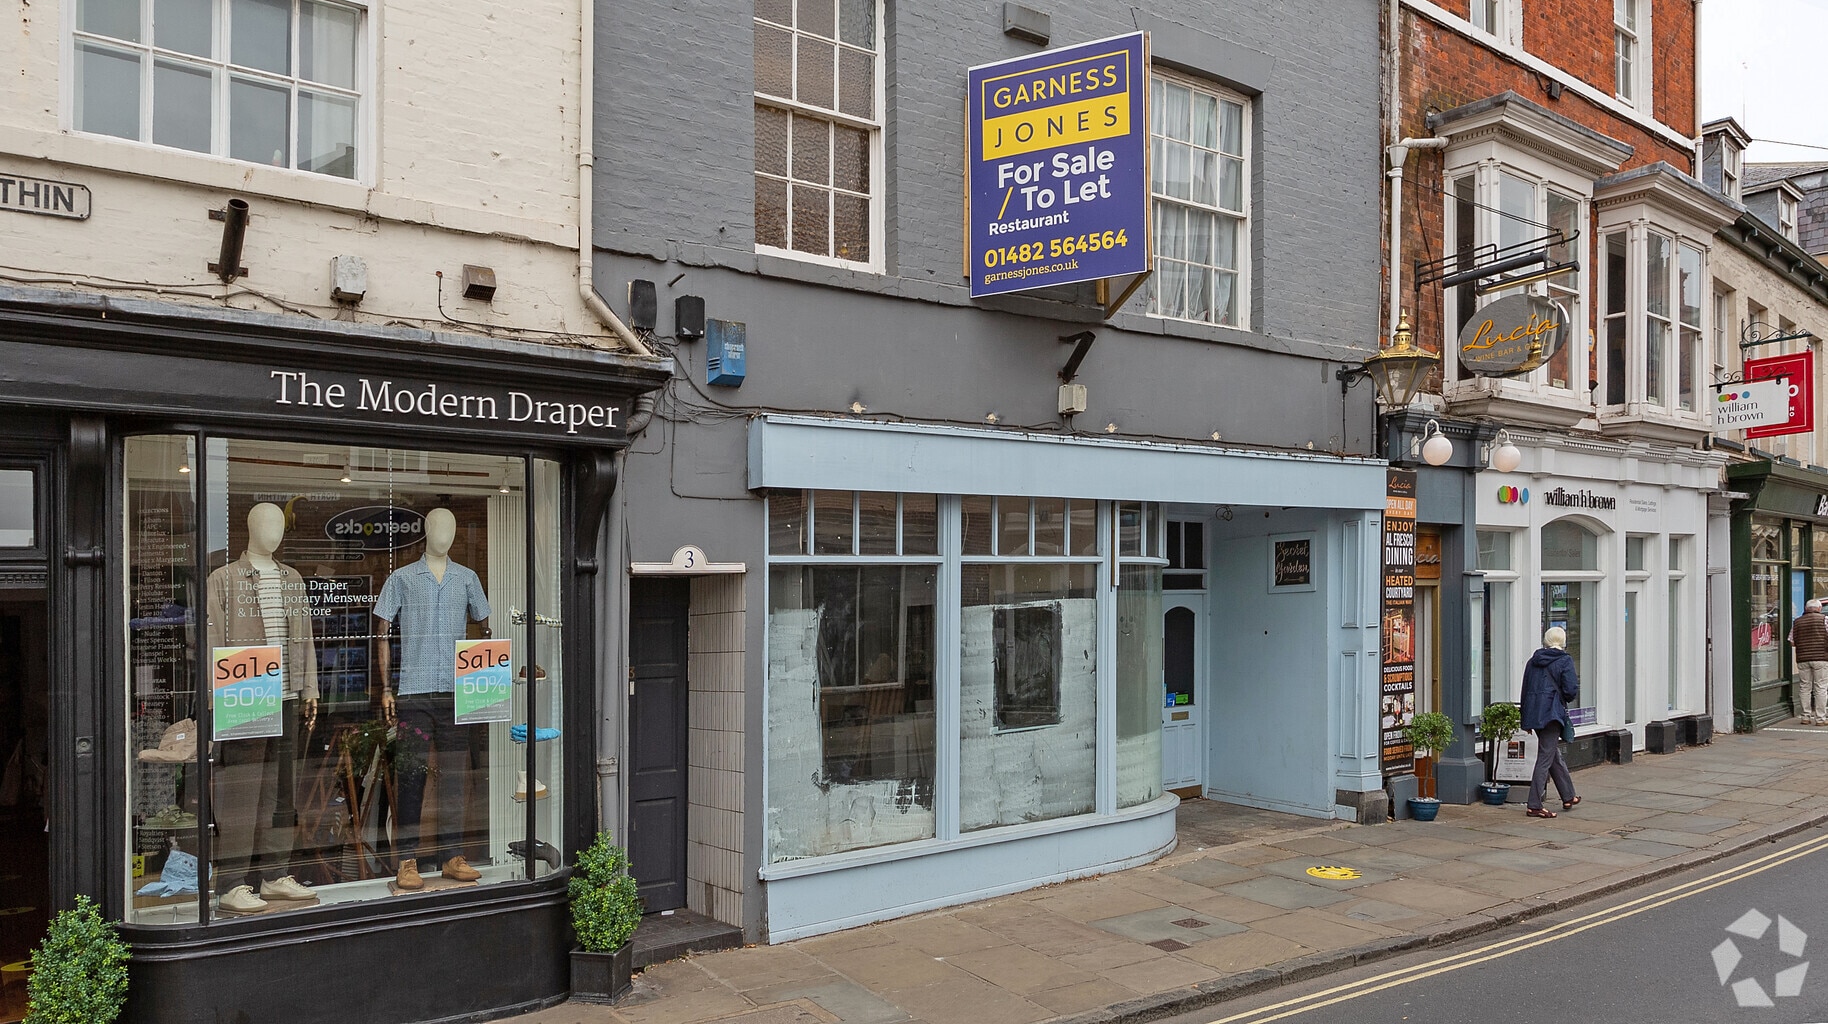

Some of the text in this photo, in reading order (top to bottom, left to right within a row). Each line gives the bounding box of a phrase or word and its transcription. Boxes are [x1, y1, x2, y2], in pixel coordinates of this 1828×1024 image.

[993, 65, 1118, 109] GARNESS
[995, 106, 1118, 148] JONES
[998, 146, 1115, 189] For Sale
[1021, 185, 1056, 211] To
[1064, 174, 1112, 205] Let
[989, 210, 1070, 236] Restaurant
[984, 229, 1128, 268] 01482 564564
[984, 259, 1079, 284] garnessjones.co.uk
[1462, 313, 1560, 352] Lucia
[1475, 353, 1495, 362] WINE
[1498, 347, 1514, 357] BAR
[270, 370, 620, 434] The Modern Draper
[1718, 402, 1758, 414] william
[1717, 411, 1764, 425] h brown
[1389, 476, 1412, 489] Lucia
[1544, 487, 1616, 510] william h brown
[1386, 521, 1414, 532] ENJOY
[1386, 533, 1414, 546] AL FRESCO
[684, 550, 694, 569] 3
[1385, 547, 1414, 566] DINING
[237, 580, 260, 591] The
[310, 580, 348, 594] Draper
[1386, 576, 1414, 586] HEATED
[323, 592, 378, 603] Menswear
[1386, 587, 1413, 598] COURTYARD
[237, 608, 246, 618] &
[301, 607, 332, 617] Store
[216, 657, 280, 680] Sale
[457, 648, 510, 670] Sale
[463, 675, 507, 695] 50%
[1384, 682, 1413, 692] COCKTAILS
[223, 686, 276, 708] 50%
